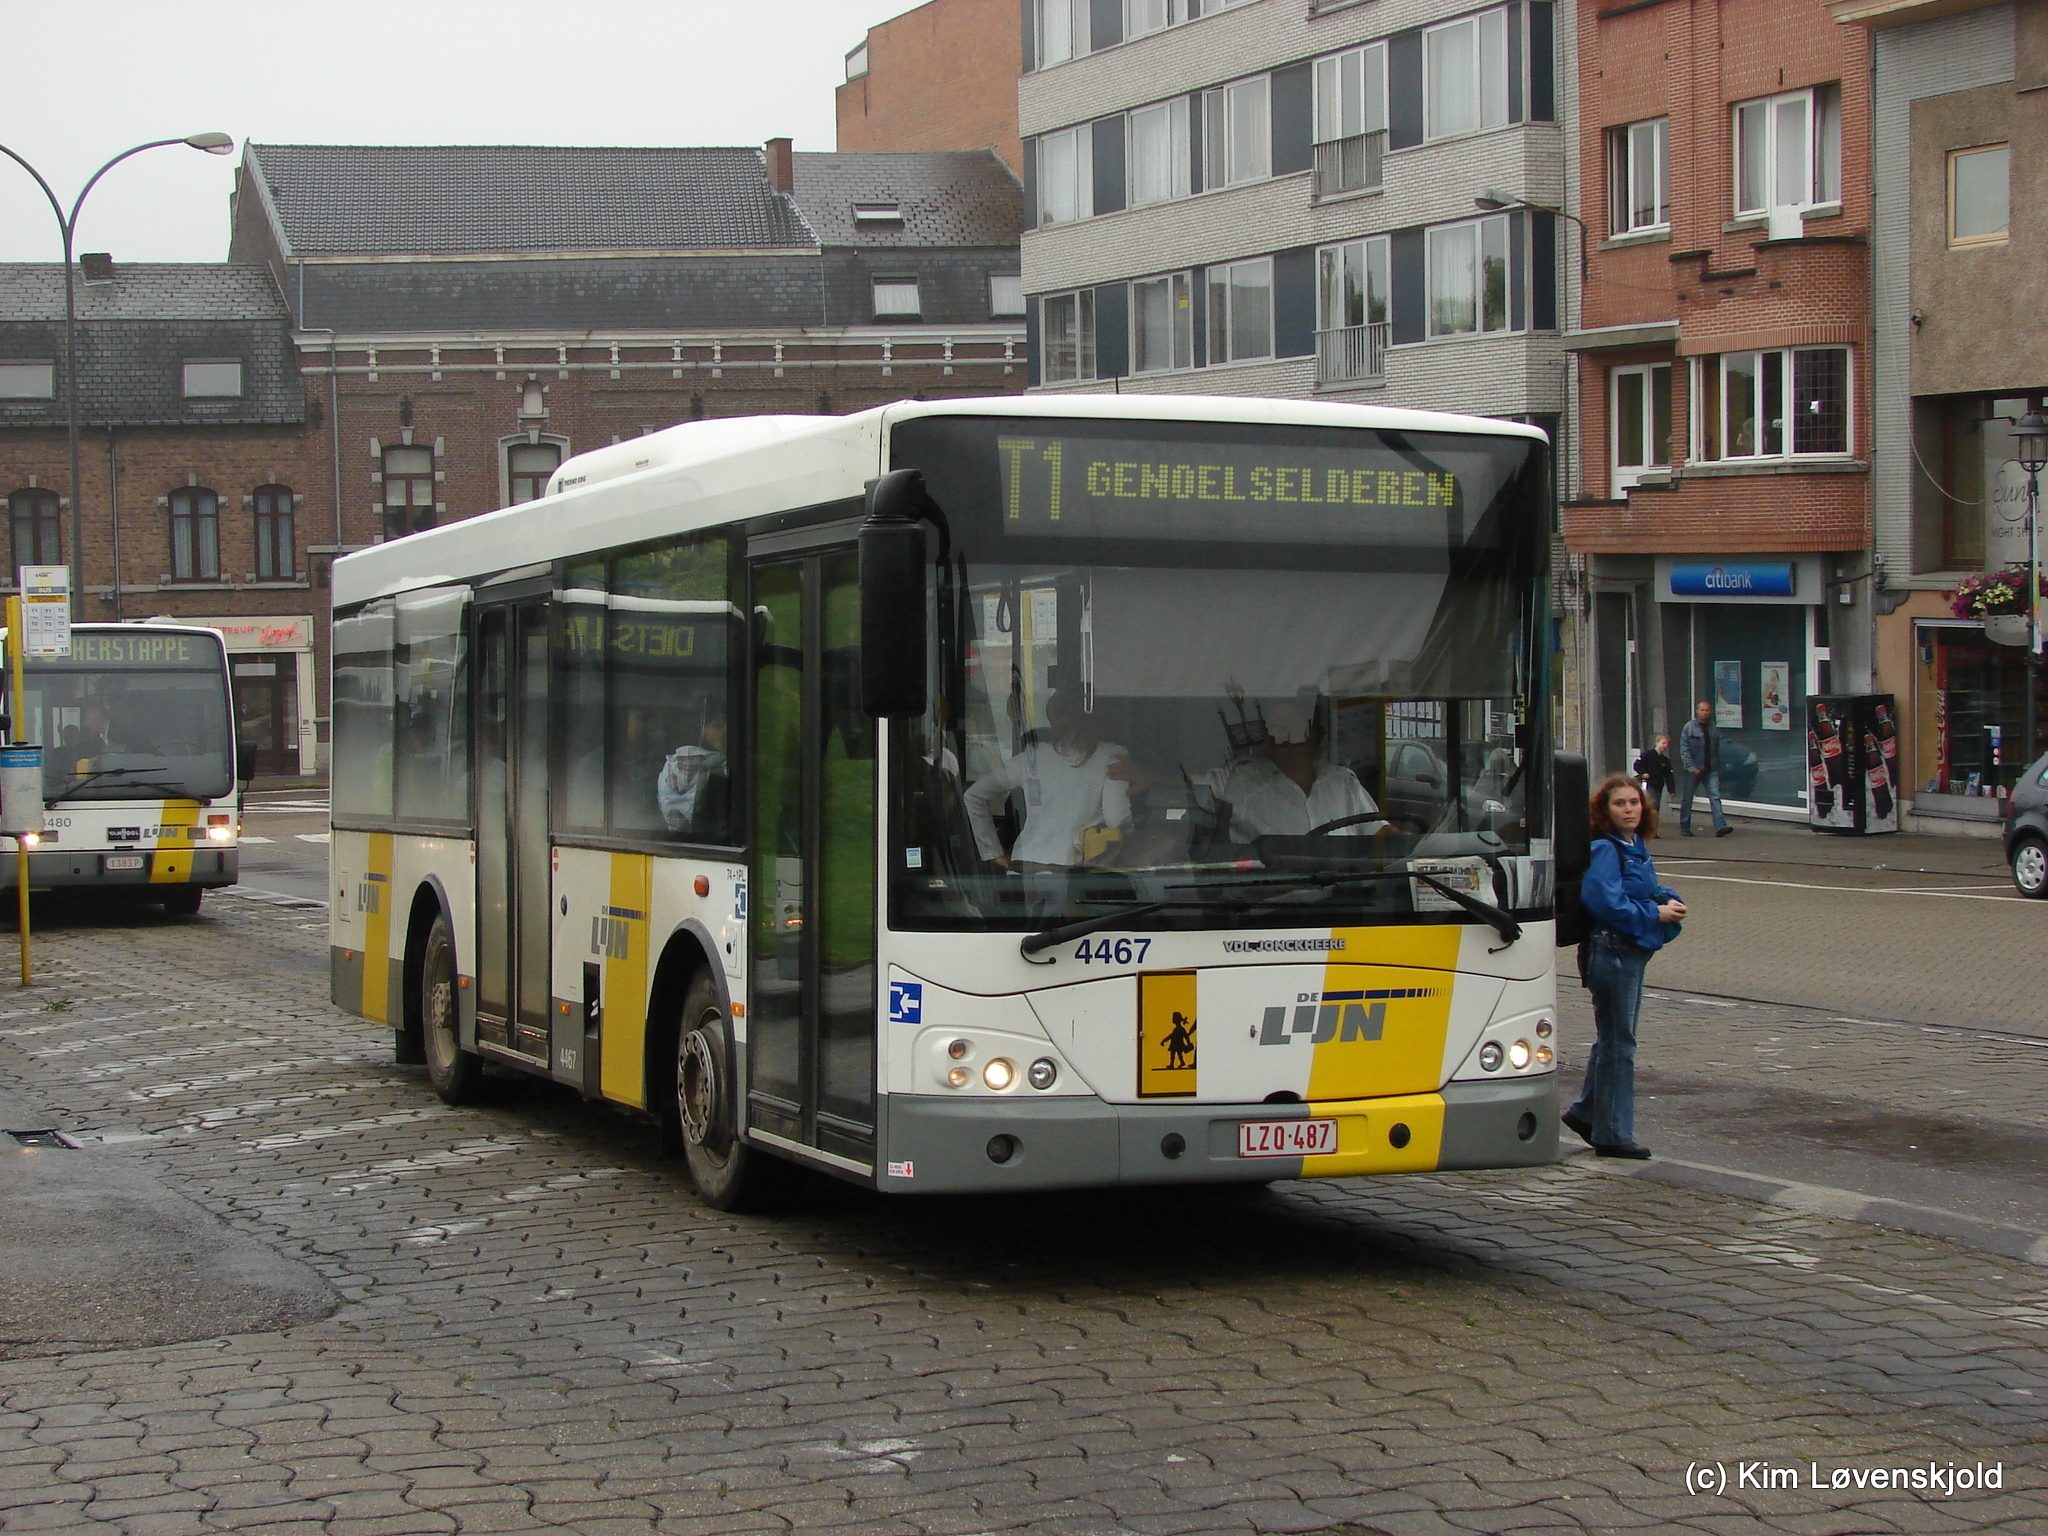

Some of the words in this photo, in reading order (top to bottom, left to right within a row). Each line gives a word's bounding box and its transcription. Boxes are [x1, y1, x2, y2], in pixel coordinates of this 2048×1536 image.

[998, 438, 1062, 521] T1
[1087, 461, 1455, 507] GENOELSELDEREN
[2016, 526, 2043, 538] SHP
[1705, 567, 1752, 589] citibank
[72, 636, 190, 662] HERSTAPPE
[591, 916, 629, 960] LIJN
[1223, 941, 1253, 953] VDL
[1255, 939, 1346, 952] JONCKHEERE
[1074, 938, 1151, 965] 4467
[1297, 993, 1318, 1002] DE
[1259, 1003, 1386, 1045] LIJN
[559, 1047, 577, 1070] 4467
